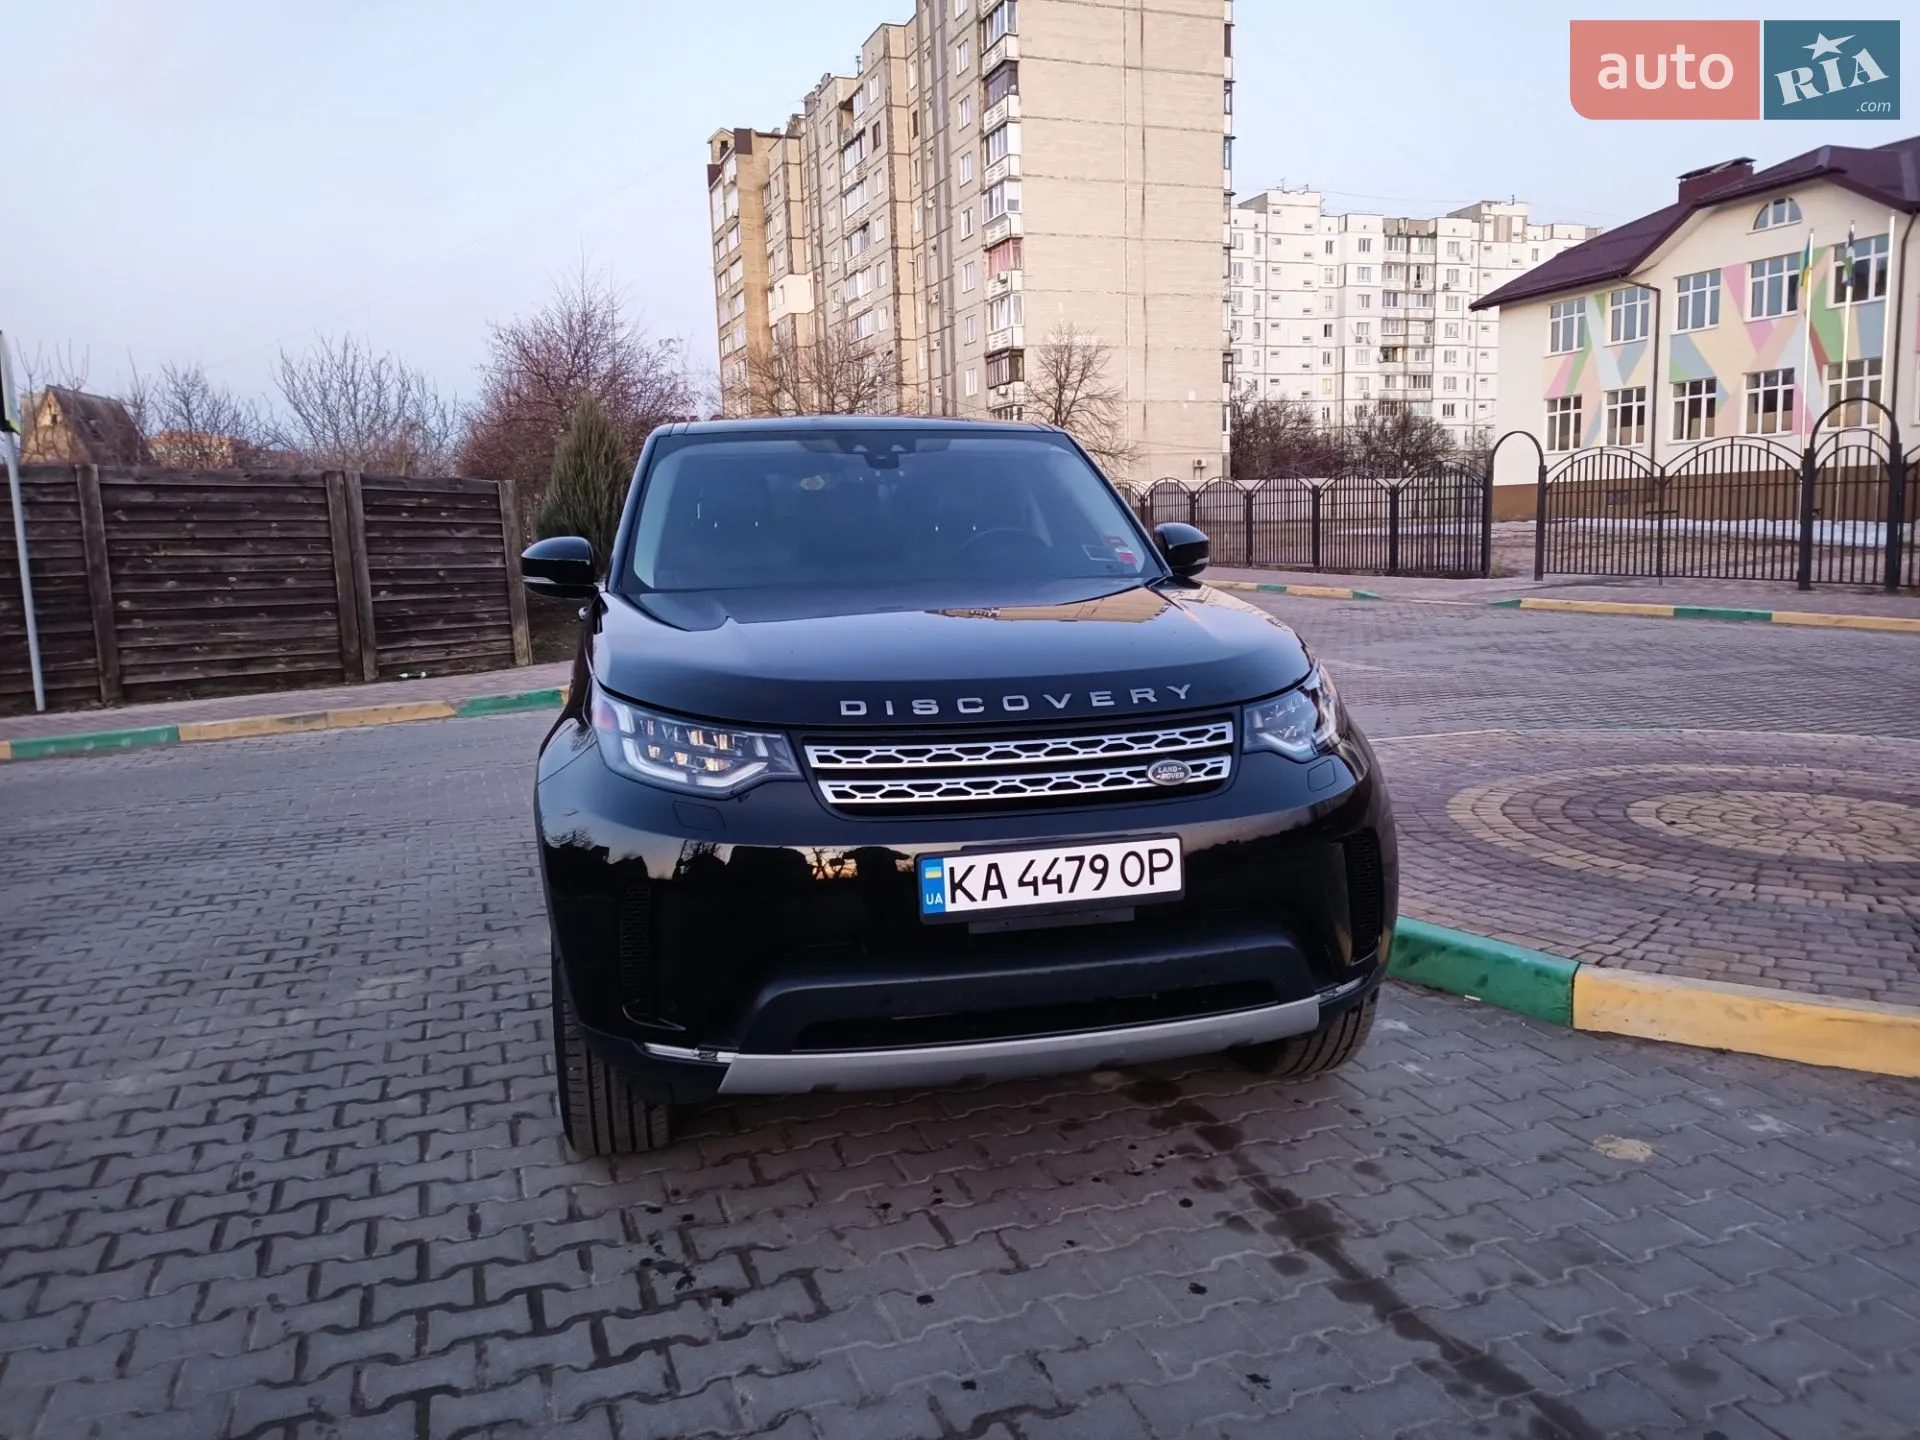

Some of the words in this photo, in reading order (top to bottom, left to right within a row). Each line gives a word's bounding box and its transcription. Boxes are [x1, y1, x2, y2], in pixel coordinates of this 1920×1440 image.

[839, 683, 1191, 716] DISCOVERY
[948, 862, 1008, 904] KA
[1017, 853, 1110, 897] 4479
[1119, 847, 1174, 888] OP
[925, 892, 943, 905] UA
